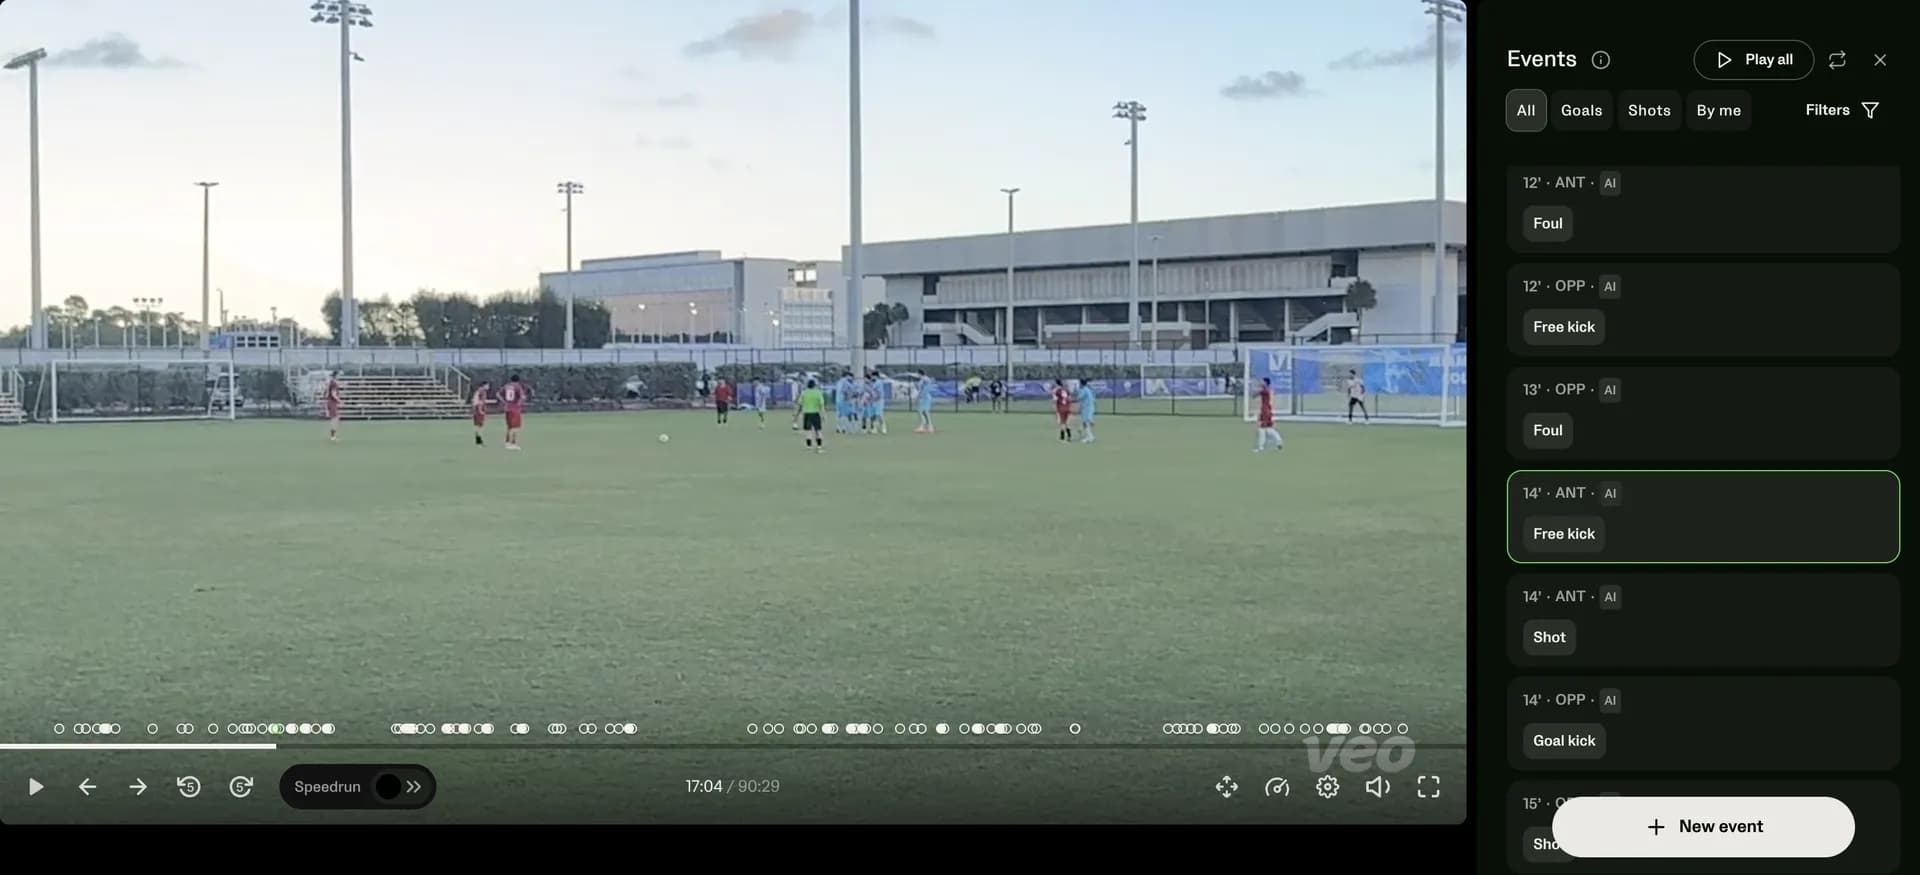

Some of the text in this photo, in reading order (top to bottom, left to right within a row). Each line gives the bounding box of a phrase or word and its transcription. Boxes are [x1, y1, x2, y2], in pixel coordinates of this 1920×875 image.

[1507, 49, 1577, 68] Events
[1745, 52, 1793, 69] Play all
[1516, 103, 1536, 117] All
[1560, 103, 1603, 117] Goals
[1627, 103, 1672, 117] Shots
[1697, 104, 1742, 121] By me
[1806, 102, 1851, 116] Filters
[1554, 176, 1587, 189] ANT
[1603, 178, 1617, 189] AI
[1533, 216, 1563, 230] Foul
[1554, 279, 1587, 292] OPP
[1603, 281, 1617, 292] AI
[1533, 319, 1596, 333] Free kick
[1554, 382, 1587, 395] OPP
[1603, 384, 1617, 395] AI
[1533, 423, 1563, 437] Foul
[1554, 486, 1587, 499] ANT
[1603, 488, 1617, 499] AI
[1533, 526, 1596, 540] Free kick
[1554, 590, 1587, 603] ANT
[1603, 592, 1617, 603] AI
[1533, 630, 1567, 644] Shot
[1554, 693, 1587, 706] OPP
[1603, 695, 1617, 706] AI
[1533, 733, 1596, 747] Goal kick
[186, 782, 195, 793] 5
[236, 782, 244, 793] 5
[294, 780, 361, 796] Speedrun
[685, 779, 724, 793] 17:04
[738, 779, 780, 793] 90:29
[1679, 818, 1764, 834] New event
[1533, 837, 1559, 851] Sho
